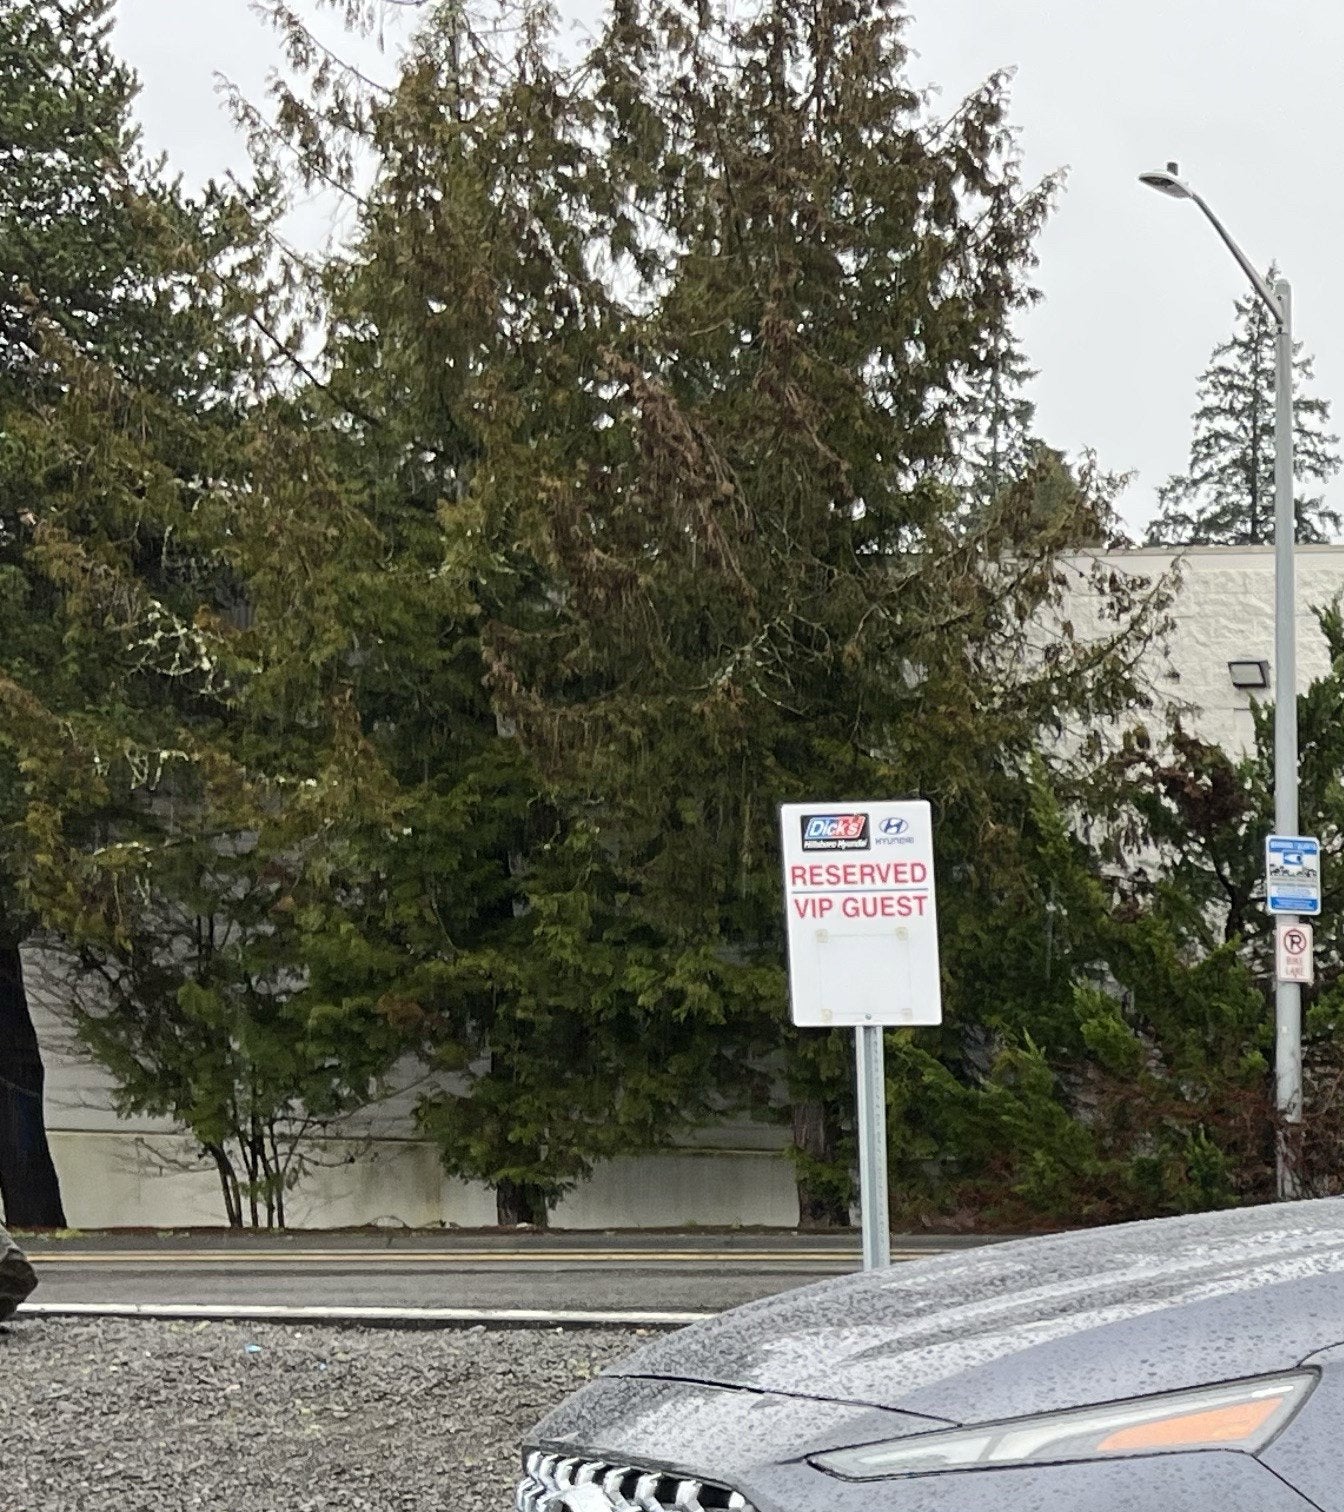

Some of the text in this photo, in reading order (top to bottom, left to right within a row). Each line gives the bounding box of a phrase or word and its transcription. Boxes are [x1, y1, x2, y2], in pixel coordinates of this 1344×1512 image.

[791, 862, 928, 886] RESERVED
[794, 896, 928, 918] VIP GUEST
